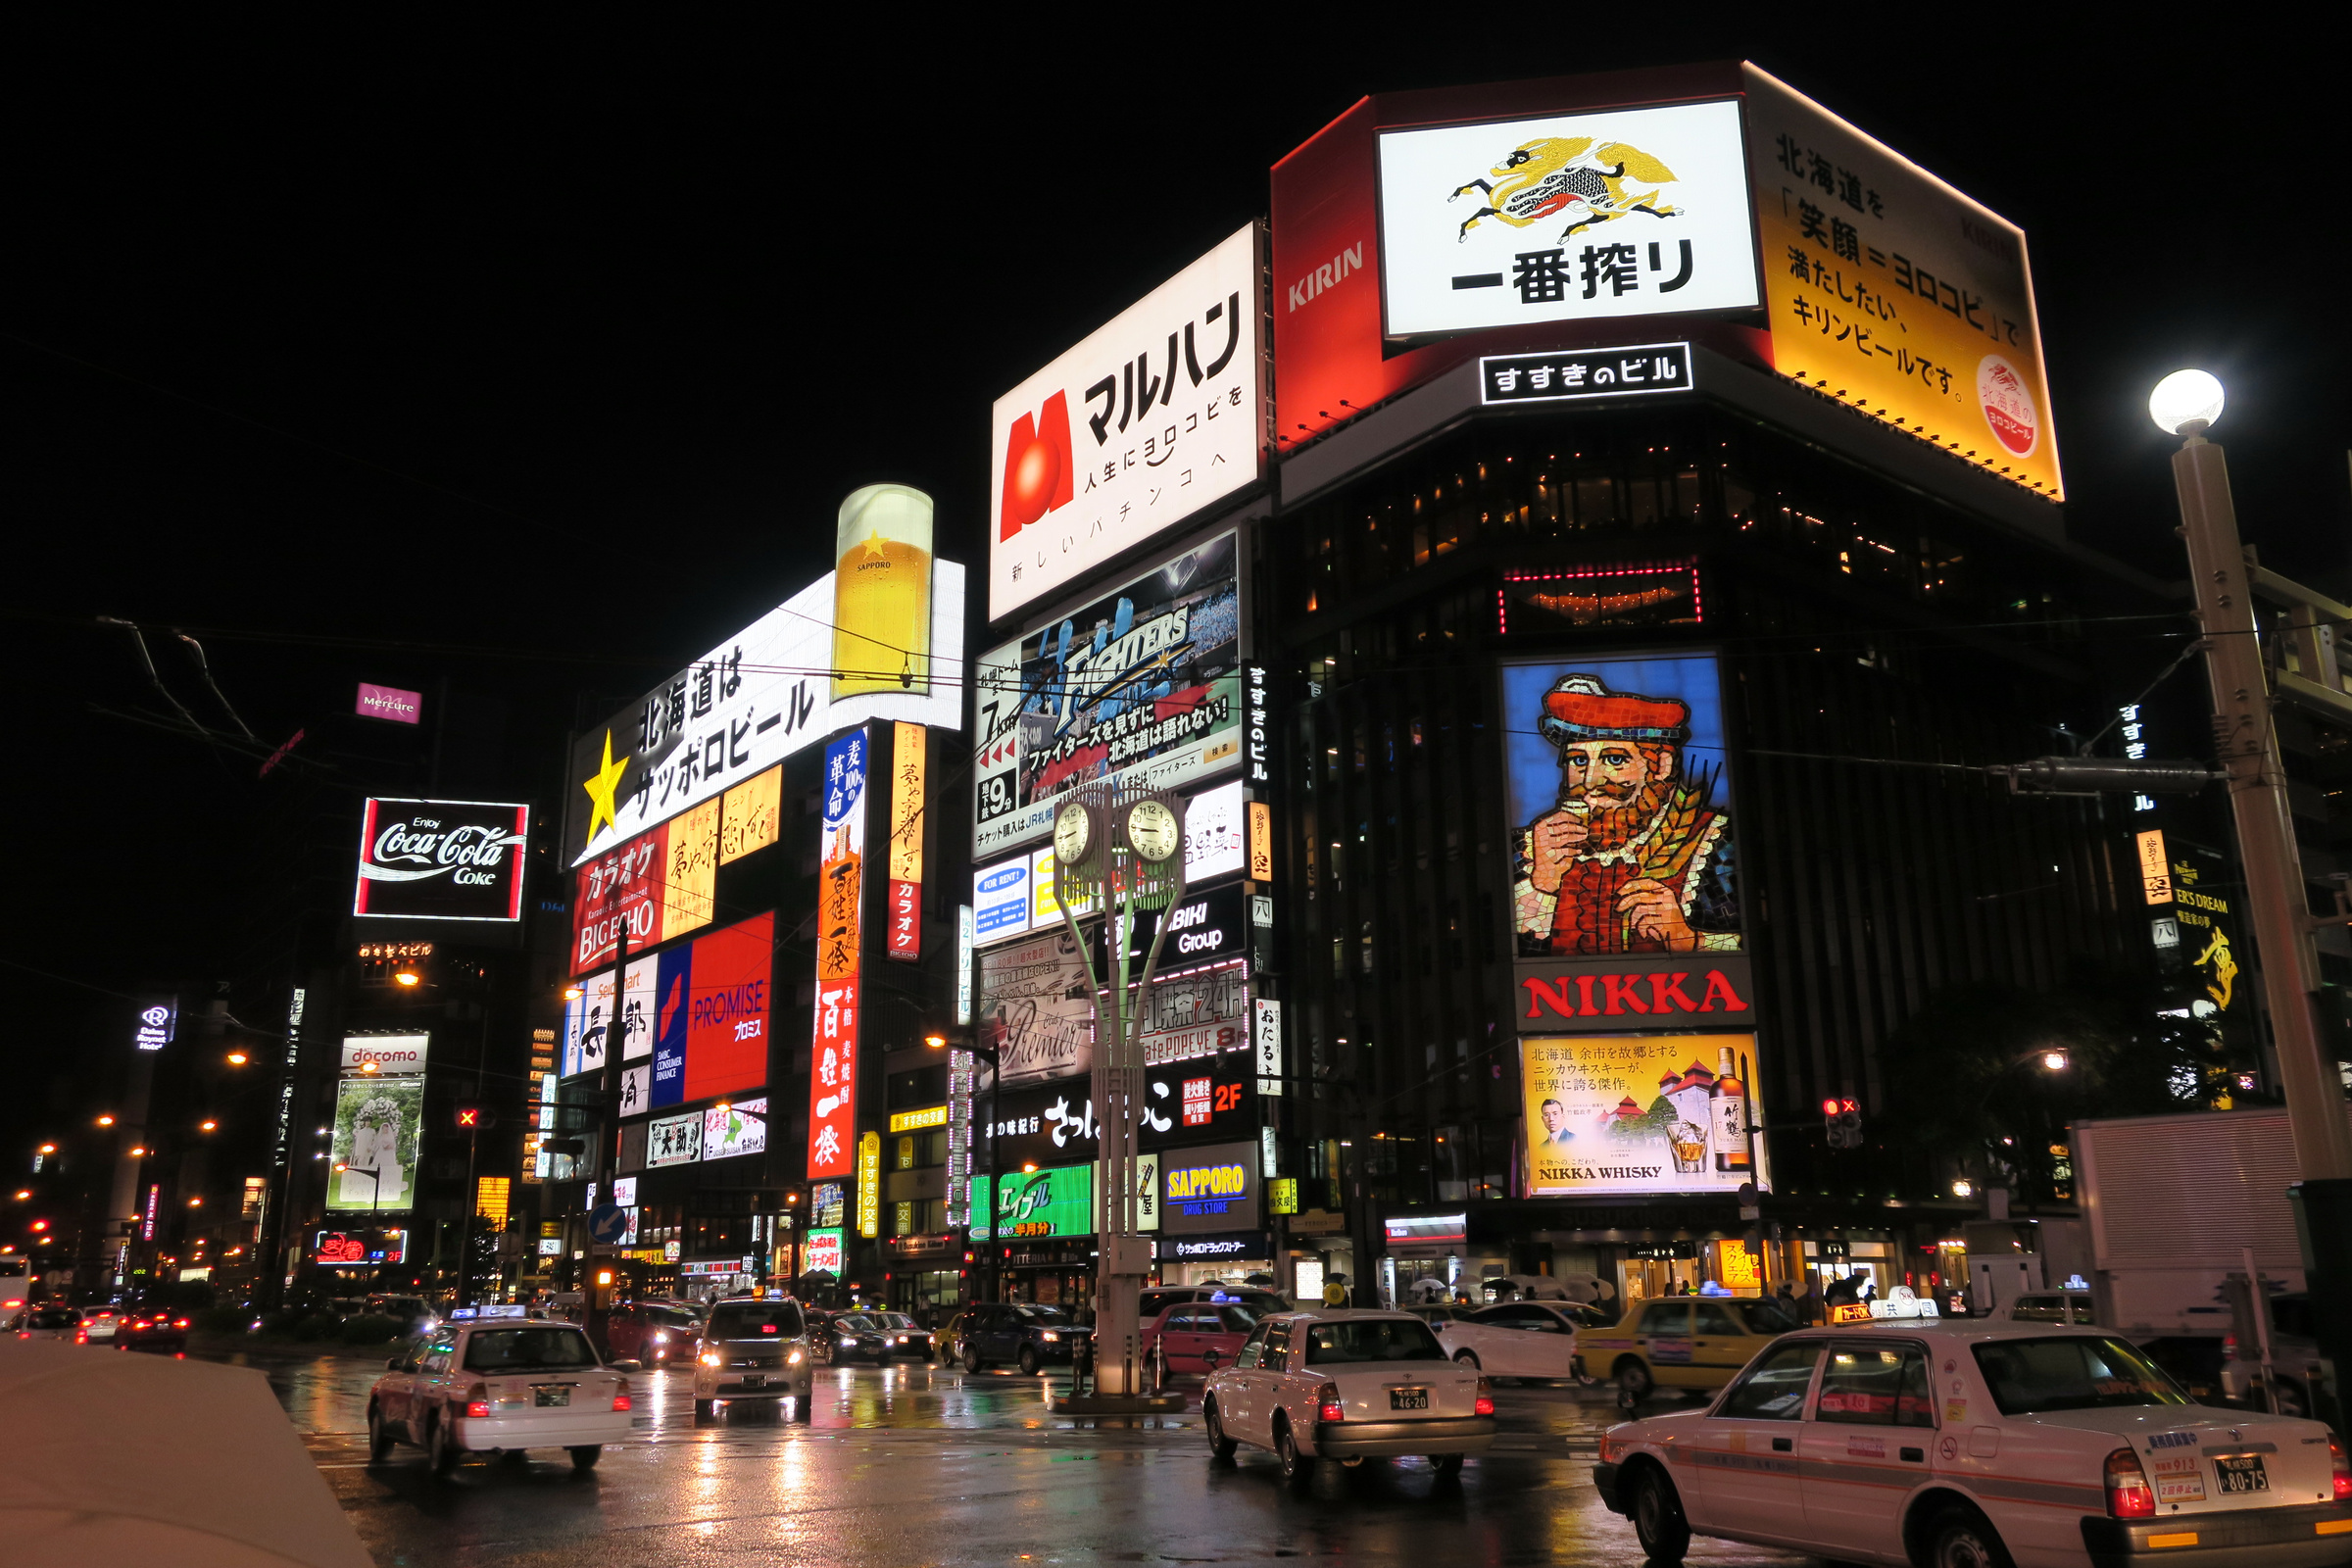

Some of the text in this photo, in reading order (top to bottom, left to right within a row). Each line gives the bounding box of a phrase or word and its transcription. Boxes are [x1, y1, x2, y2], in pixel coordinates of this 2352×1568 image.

[1776, 132, 1885, 220] 北海道を
[1287, 240, 1363, 314] KIRIN
[1450, 238, 1694, 306] 一番搾り
[1788, 244, 1907, 334] 満たしたい、
[1792, 295, 1964, 403] キリンビールです。
[1084, 290, 1241, 449] マルハン
[1494, 356, 1679, 392] すすきのビル
[1084, 385, 1242, 494] 人生にヨロコビを
[1010, 453, 1227, 584] 新しいパチンコへ
[857, 560, 892, 572] SAPPORO
[980, 659, 1018, 688] 札幌ドーム
[1054, 605, 1191, 738] FIGHTERS
[364, 696, 415, 713] Mercure
[637, 644, 744, 754] 北海道は
[1249, 666, 1268, 782] すすきのビル
[1028, 702, 1155, 772] ファイターズを見ずに
[632, 678, 816, 820] サッポロビール
[2119, 704, 2156, 812] すすきル
[1152, 755, 1197, 780] ファイターズ
[828, 754, 845, 817] 革命
[981, 782, 990, 820] 地下鉄
[1139, 807, 1147, 816] 11
[1148, 805, 1156, 814] 12
[413, 817, 441, 830] Enjoy
[1133, 813, 1142, 823] 10
[1159, 810, 1163, 819] 1
[1164, 818, 1170, 827] 2
[373, 823, 509, 867] Coca-Cola
[1133, 834, 1140, 843] 8
[1163, 840, 1169, 849] 4
[1167, 830, 1173, 839] 3
[1141, 843, 1147, 853] 7
[1149, 848, 1154, 857] 6
[1157, 846, 1163, 856] 5
[454, 866, 496, 886] Coke
[586, 842, 656, 903] カラオケ
[983, 870, 1020, 891] FOR RENT!
[588, 905, 609, 921] Karaoke
[609, 886, 649, 912] Entertainment
[896, 883, 914, 947] カラオケ
[2195, 894, 2229, 914] DREAM
[1179, 929, 1223, 955] Group
[1197, 969, 1246, 1024] 24H
[1521, 968, 1749, 1019] NIKKA
[694, 980, 764, 1031] PROMISE
[140, 1026, 166, 1036] Daiwa
[734, 1017, 762, 1043] プロミス
[352, 1048, 417, 1063] docomo
[657, 1050, 671, 1061] SMBC
[839, 985, 854, 1105] 本格 麦焼酎
[1144, 1041, 1163, 1062] afe
[1166, 1030, 1212, 1056] POPEYE
[1531, 1045, 1678, 1061] 北海道 余市を故郷とする
[656, 1069, 677, 1082] FINANCE
[657, 1058, 683, 1071] CONSUMER
[814, 989, 843, 1167] 百姓一揆
[1183, 1079, 1211, 1100] 炭火焼き
[1533, 1076, 1633, 1093] 世界に誇る傑作。
[1214, 1083, 1243, 1112] 2F
[903, 1107, 946, 1128] すすきの交番
[985, 1116, 1040, 1140] 北の味紀行
[1190, 1113, 1205, 1124] 個室
[1724, 1103, 1740, 1138] 竹鶴
[1167, 1164, 1245, 1199] SAPPORO
[1539, 1165, 1663, 1181] NIKKA WHISKY
[863, 1154, 878, 1236] すすきの交番
[998, 1182, 1053, 1220] エイブル
[1183, 1200, 1229, 1216] DRUG STORE
[1560, 1209, 1678, 1226] SUSUKINO
[387, 1250, 403, 1262] 2F
[1012, 1252, 1047, 1265] TTERIA
[1184, 1242, 1246, 1255] サッポロドラッグストアー
[1726, 1245, 1738, 1284] スクエア
[1842, 1306, 1871, 1320] カードOK
[1886, 1301, 1933, 1316] 共 同
[1398, 1396, 1427, 1409] 46-20
[2174, 1458, 2196, 1471] 913
[2225, 1458, 2254, 1470] 札幌500
[2229, 1470, 2267, 1493] 80-75
